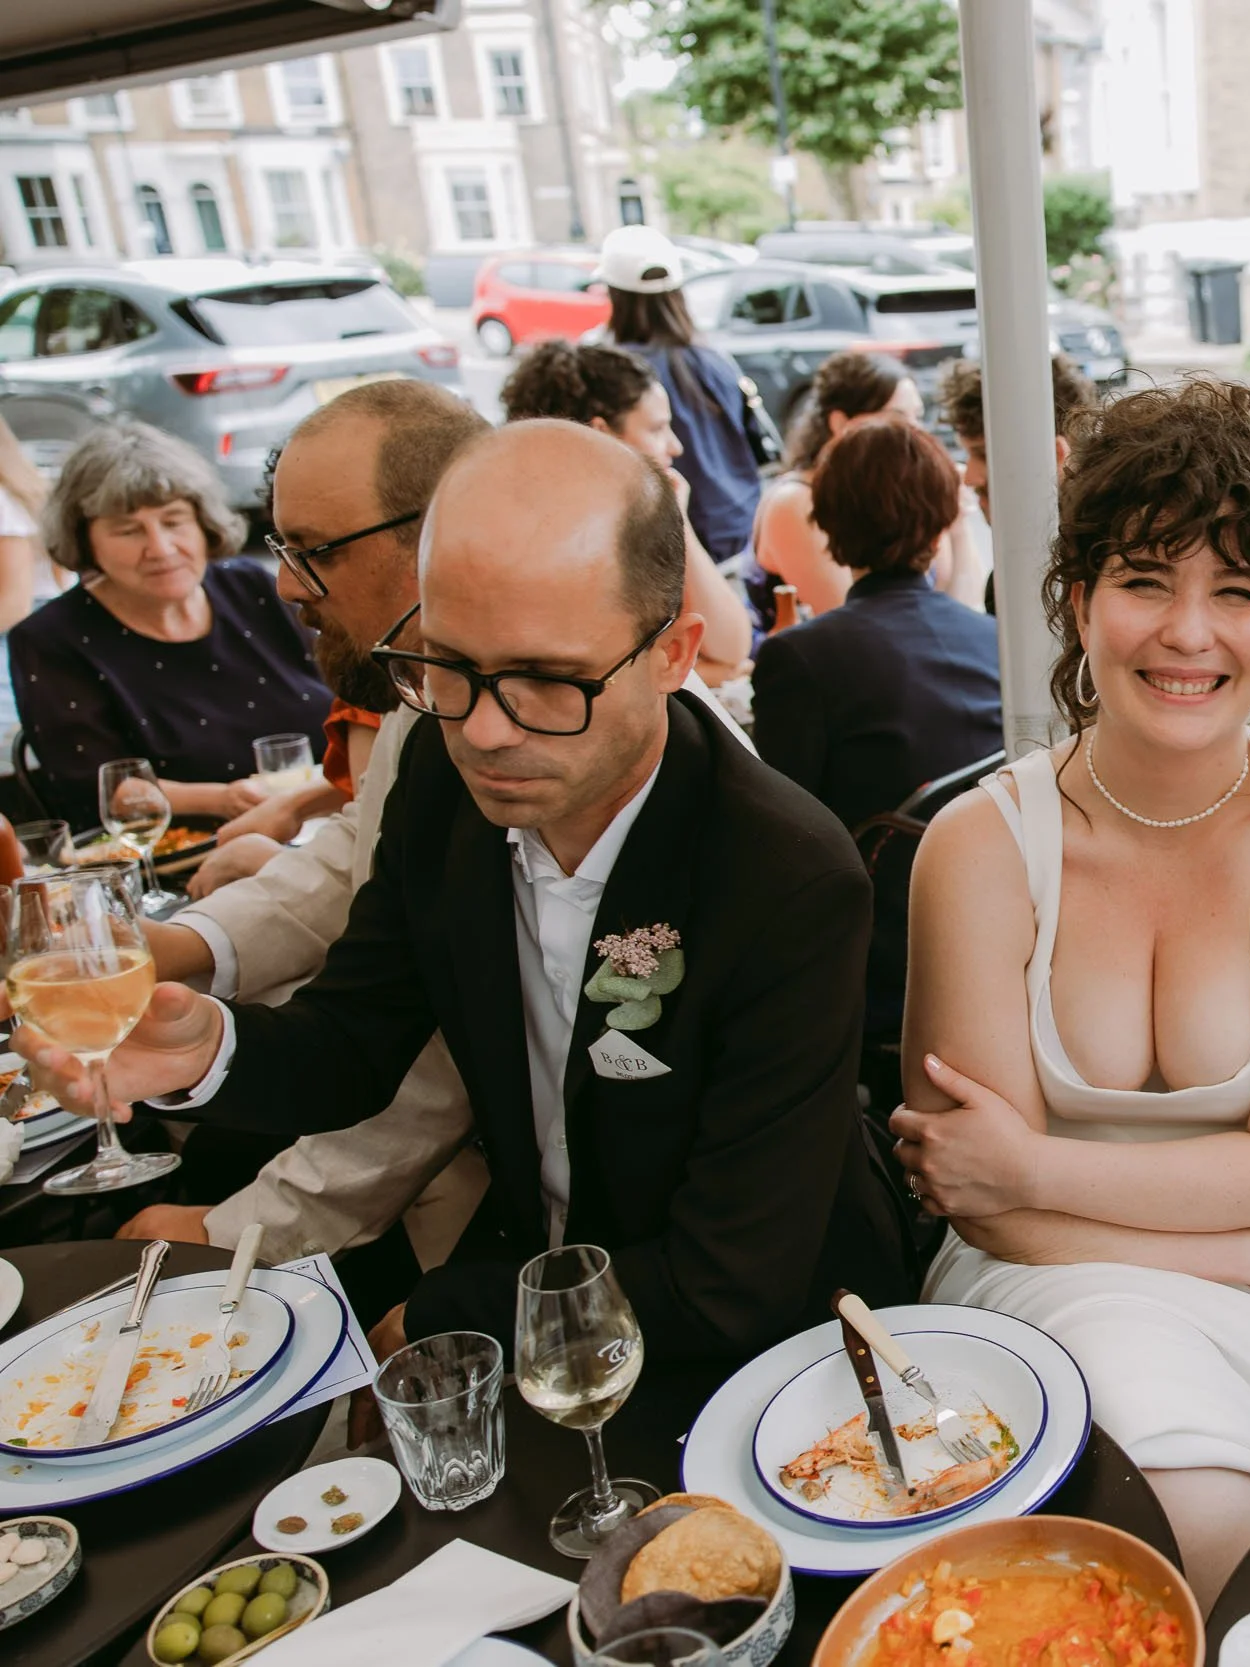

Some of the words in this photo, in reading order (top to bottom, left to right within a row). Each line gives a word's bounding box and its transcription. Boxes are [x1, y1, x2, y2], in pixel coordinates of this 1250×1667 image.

[600, 1051, 612, 1064] B
[615, 1054, 633, 1072] &
[635, 1058, 647, 1071] B
